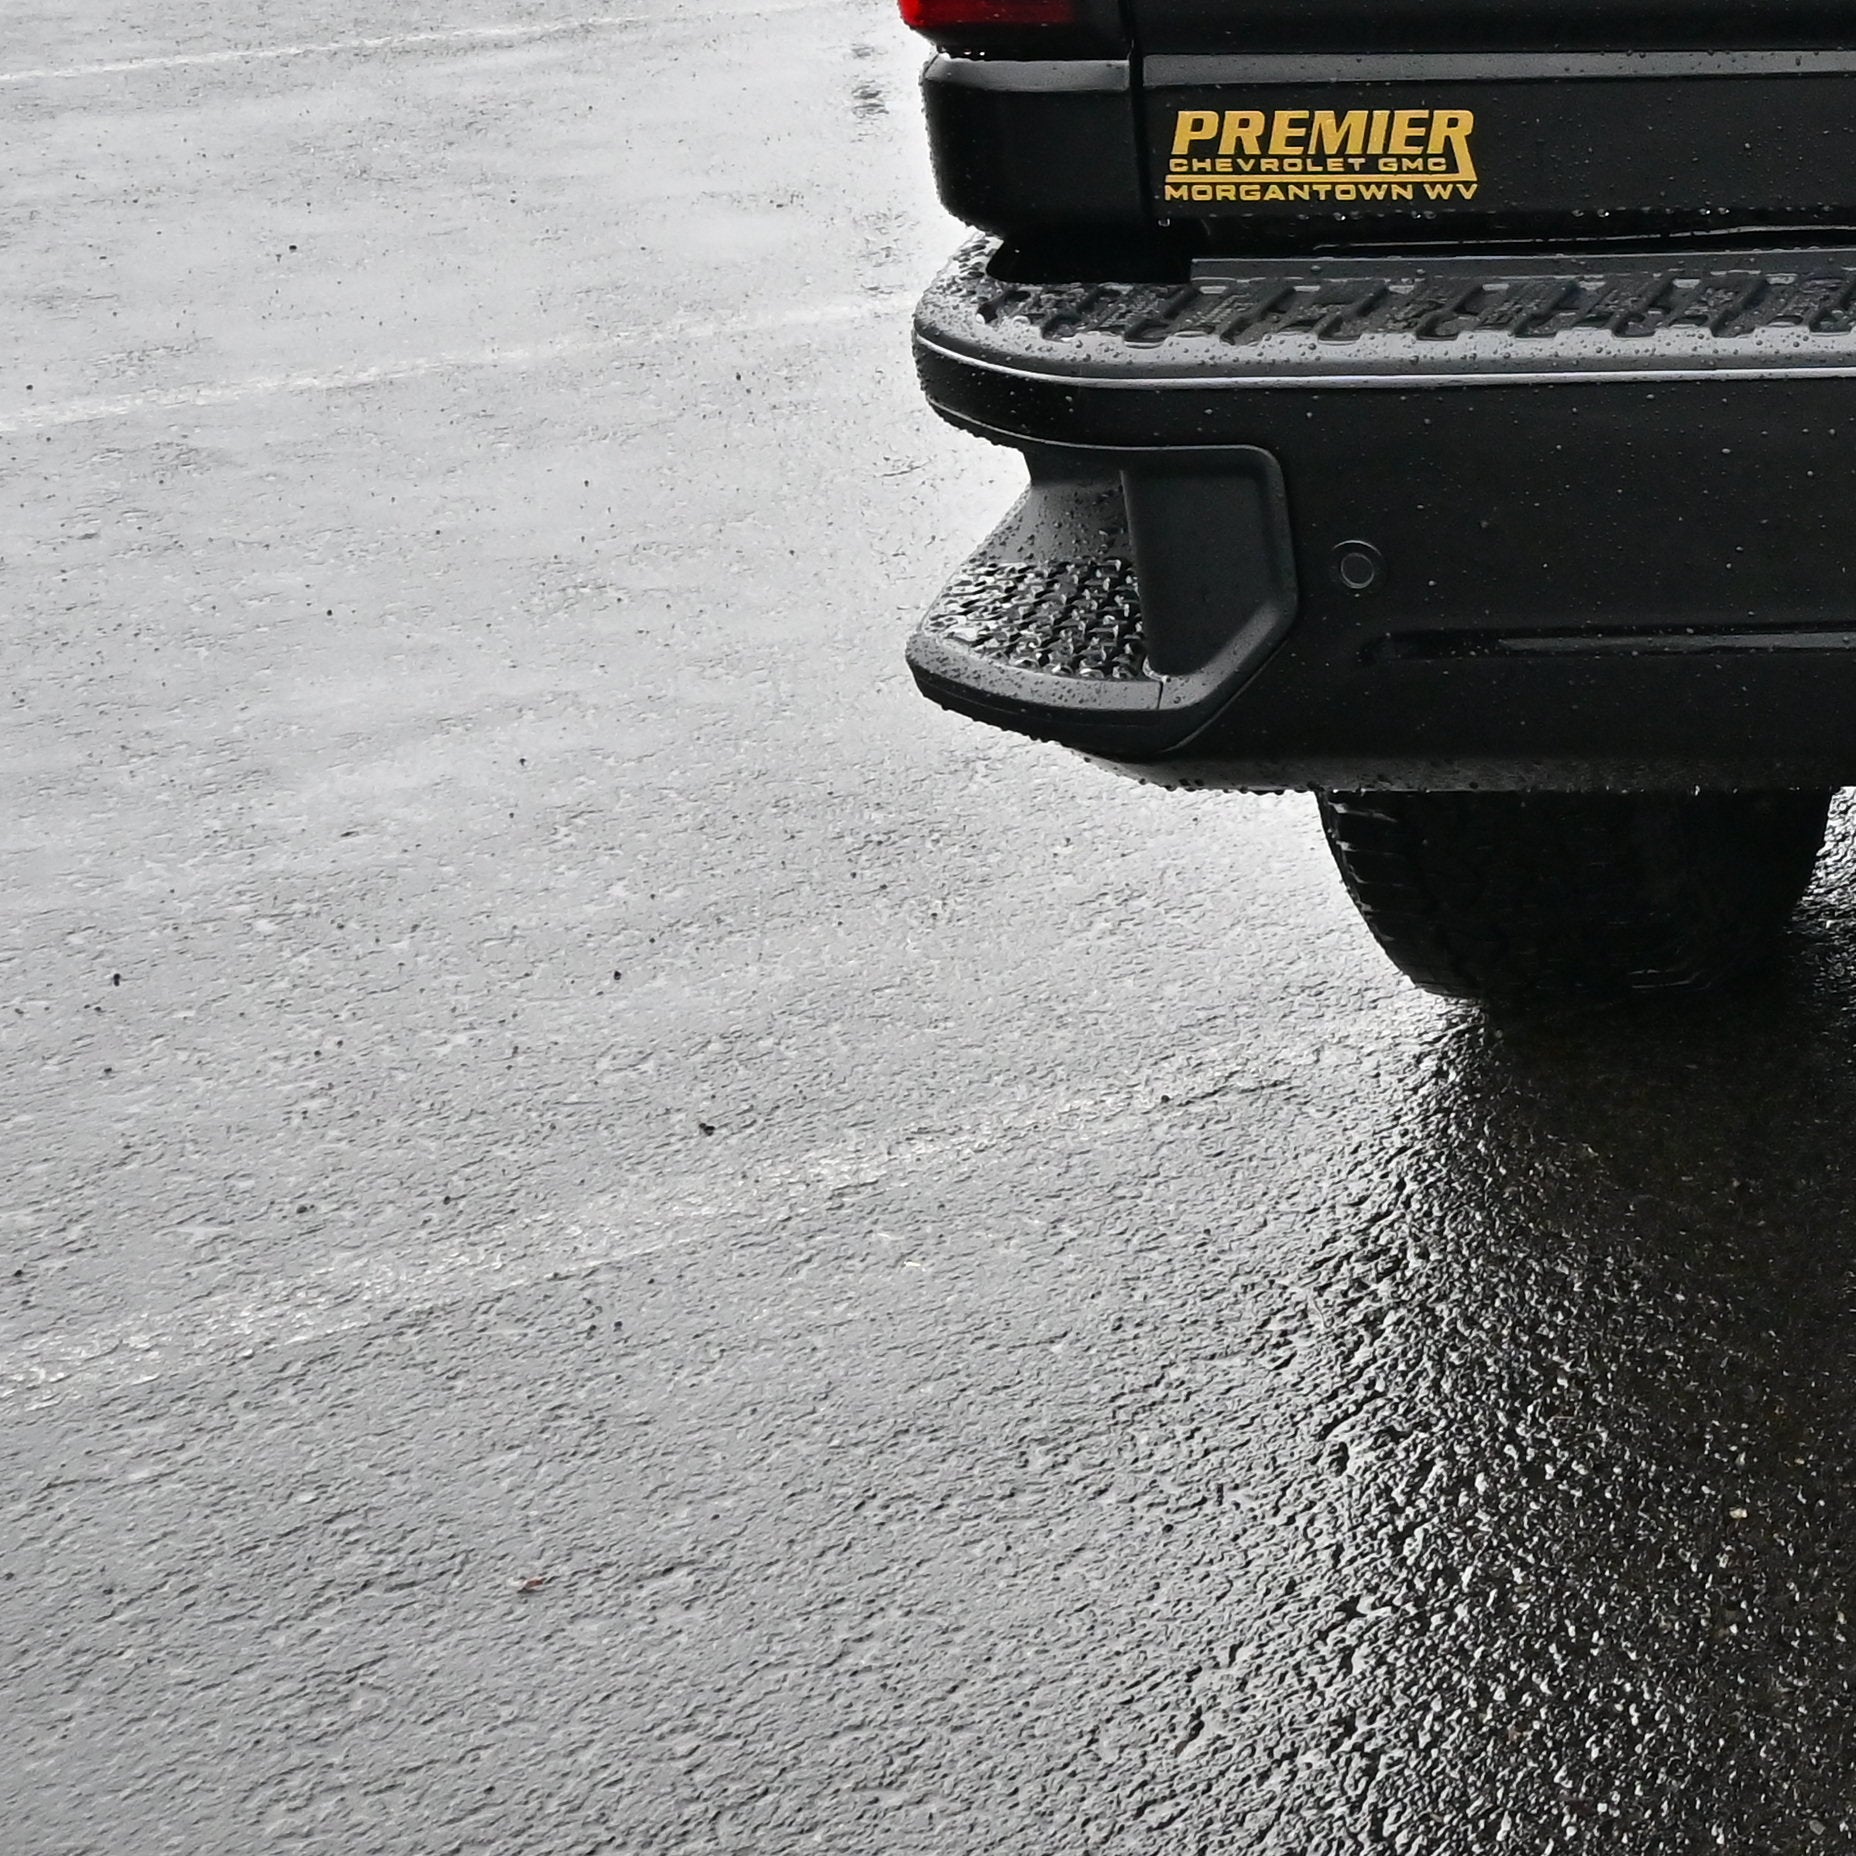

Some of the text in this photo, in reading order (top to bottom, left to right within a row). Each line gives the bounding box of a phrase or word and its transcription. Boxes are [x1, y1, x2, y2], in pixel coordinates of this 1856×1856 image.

[1170, 109, 1478, 182] PREMIER
[1168, 157, 1448, 173] CHEVROLET GMC
[1164, 183, 1479, 202] MORGANTOWN WV
